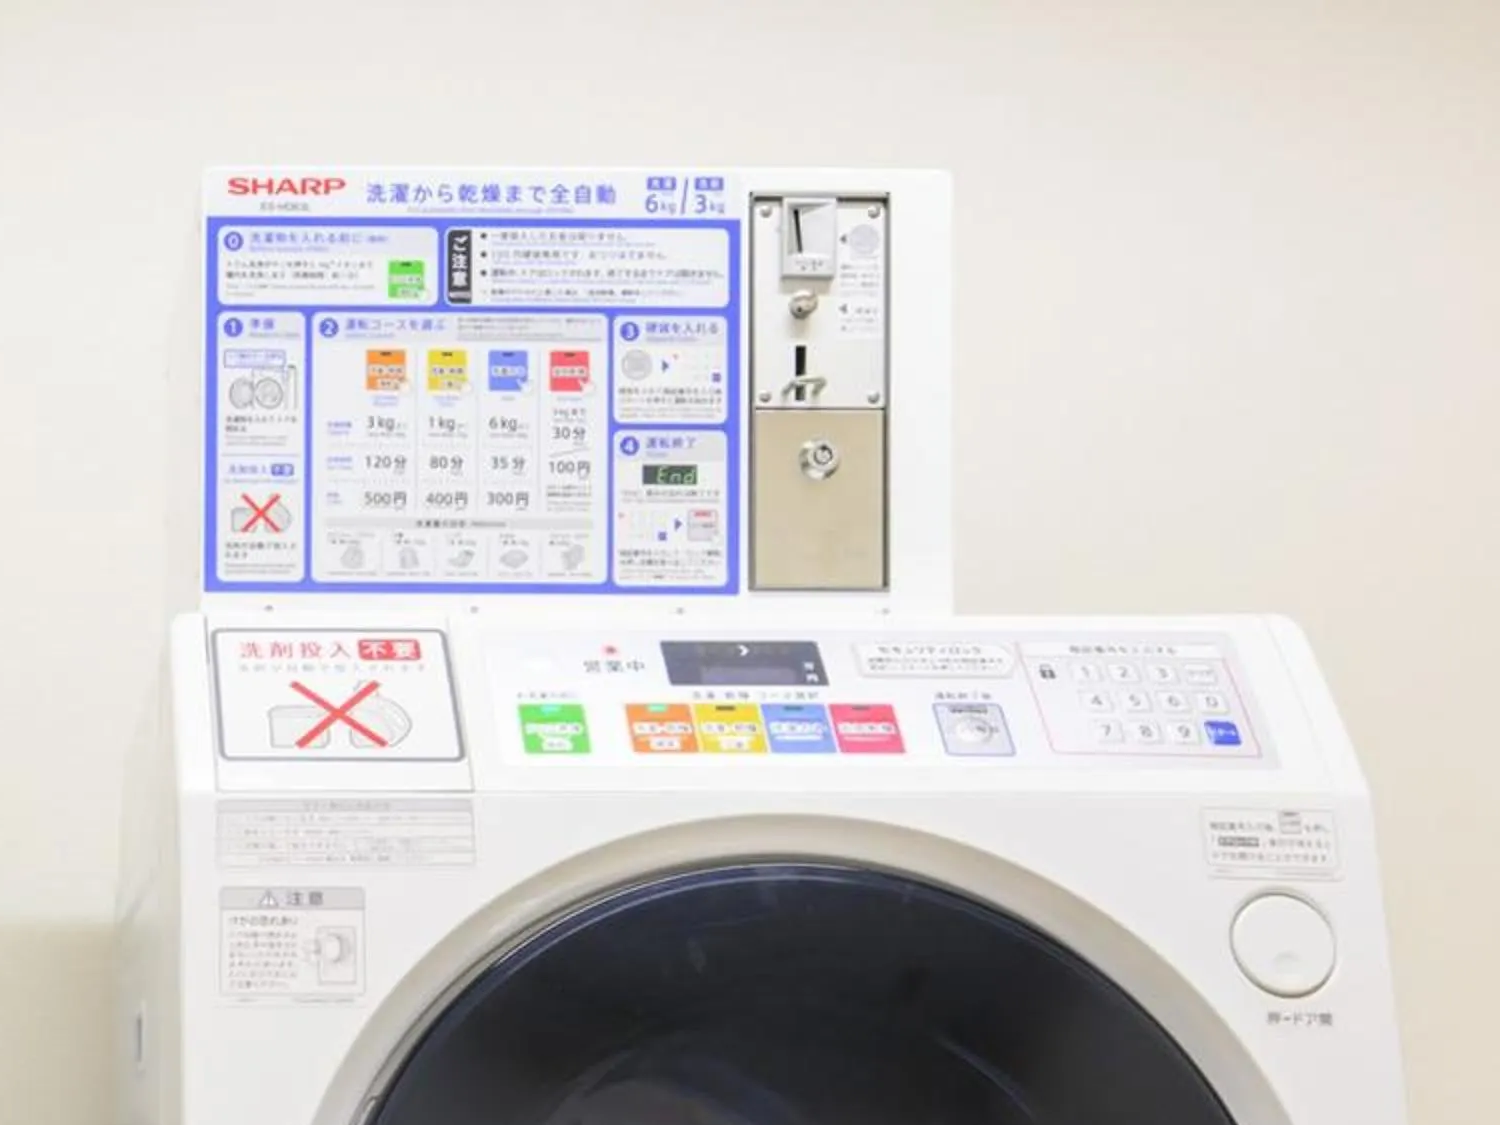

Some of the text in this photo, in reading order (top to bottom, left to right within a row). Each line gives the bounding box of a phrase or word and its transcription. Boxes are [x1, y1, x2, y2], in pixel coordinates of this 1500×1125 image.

[228, 178, 346, 195] SHARP
[367, 183, 616, 205] 洗濯から乾燥まで全自動
[451, 233, 469, 287] ご注意
[552, 426, 586, 441] 30分
[364, 455, 407, 470] 120分
[429, 455, 464, 470] 80分
[491, 455, 527, 470] 35分
[549, 459, 592, 475] 100円
[656, 467, 697, 484] End
[364, 490, 407, 506] 500円
[425, 490, 468, 506] 400円
[486, 491, 530, 507] 300円
[240, 641, 351, 659] 洗剤投入
[1118, 665, 1131, 679] 2
[1157, 667, 1170, 681] 3
[1091, 694, 1103, 707] 4
[1129, 694, 1142, 708] 5
[1167, 694, 1181, 708] 6
[1101, 723, 1113, 737] 7
[1139, 724, 1152, 738] 8
[1177, 724, 1191, 738] 9
[286, 891, 324, 906] 注意
